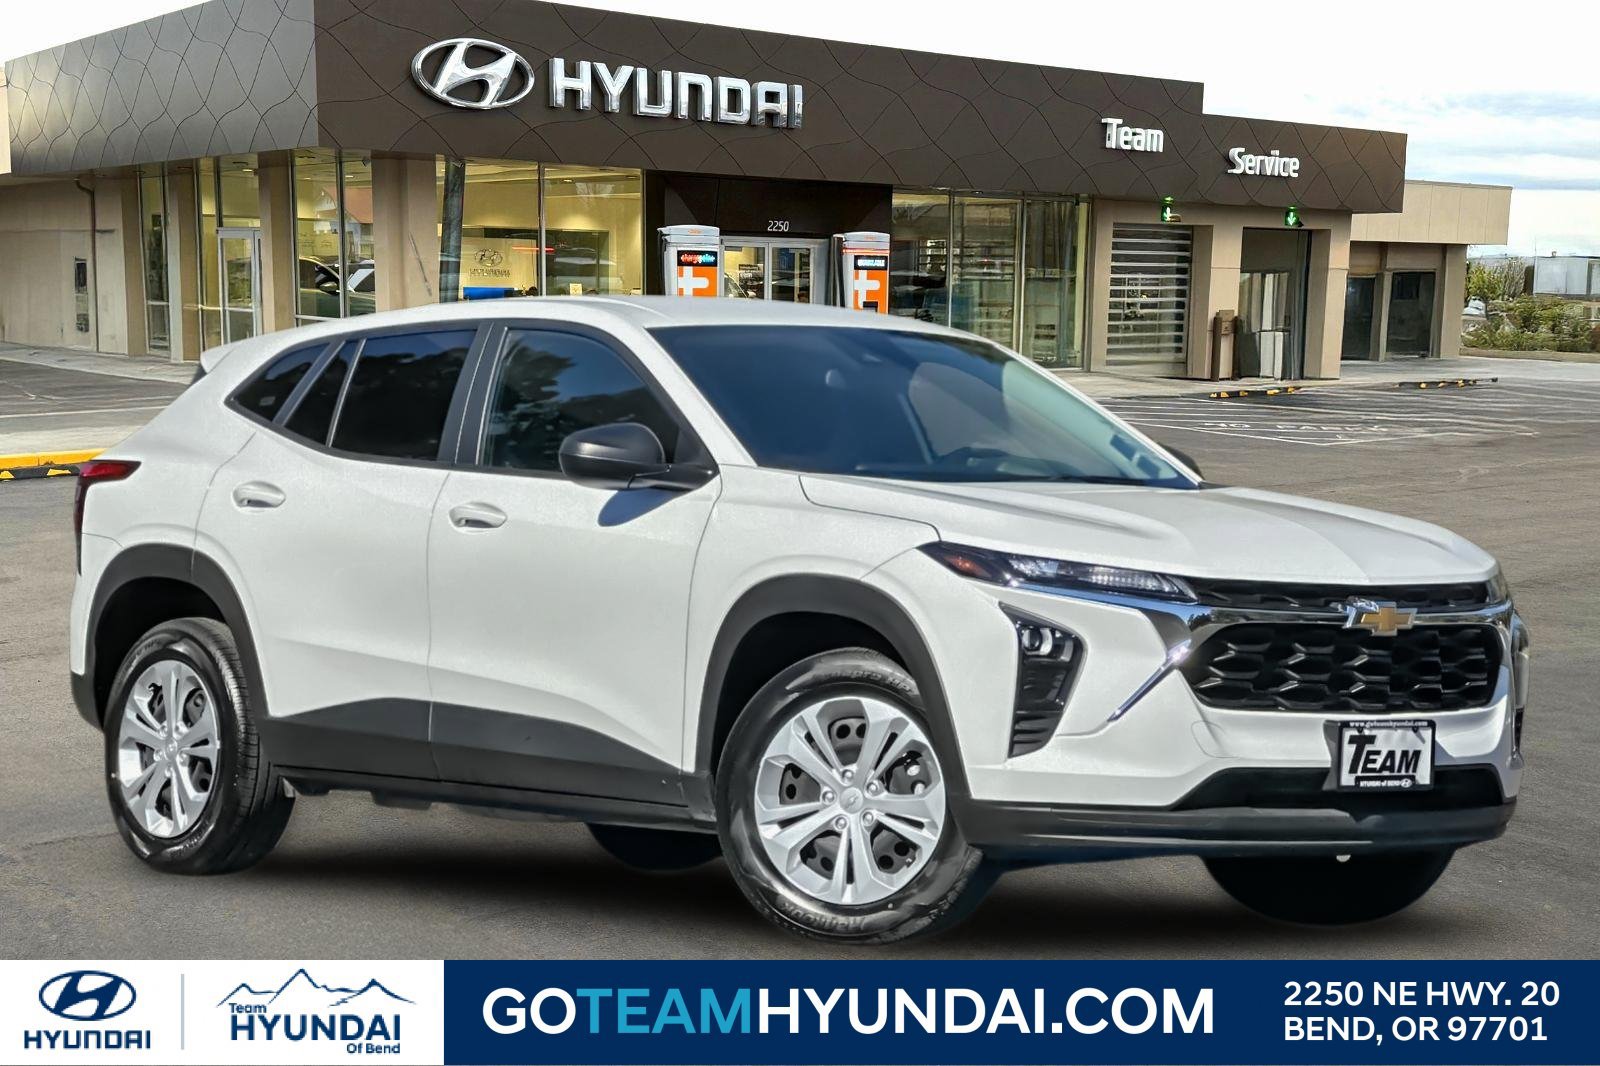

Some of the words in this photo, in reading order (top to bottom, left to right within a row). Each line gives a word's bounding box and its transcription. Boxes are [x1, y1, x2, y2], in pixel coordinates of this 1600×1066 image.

[548, 57, 803, 129] HYUNDAI
[1101, 117, 1164, 152] Team
[1227, 147, 1300, 178] Service
[767, 220, 790, 232] 2250
[1348, 735, 1421, 774] TEAM
